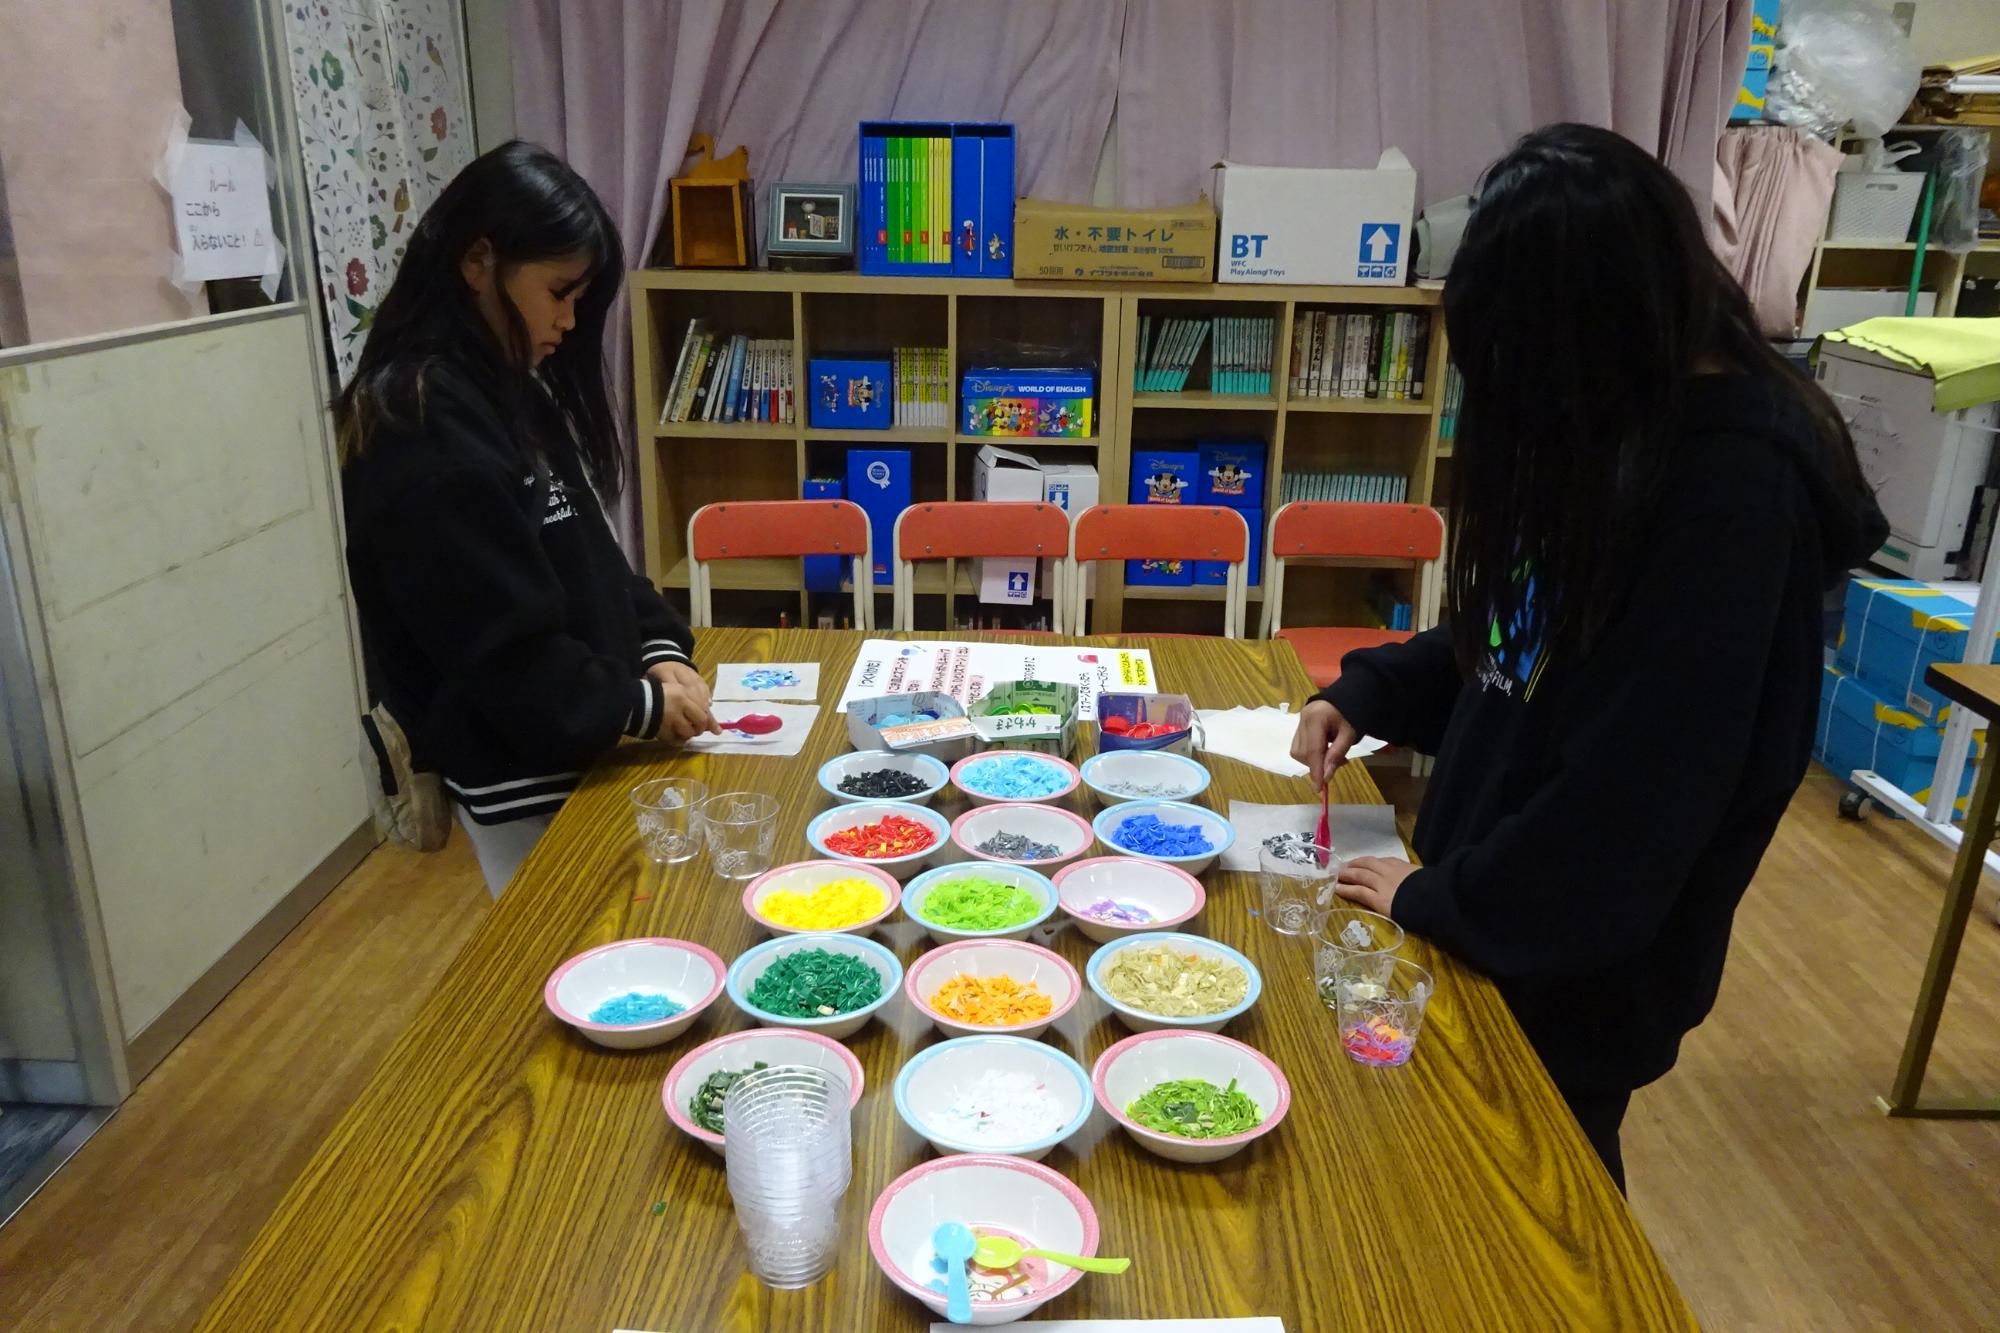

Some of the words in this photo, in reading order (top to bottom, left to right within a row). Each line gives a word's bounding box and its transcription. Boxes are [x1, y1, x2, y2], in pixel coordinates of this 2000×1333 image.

[185, 201, 222, 217] ここから
[1054, 225, 1175, 242] 水・不要トイレ
[1231, 234, 1269, 259] BT
[1230, 260, 1247, 268] WFC
[1230, 268, 1246, 277] Play
[1268, 269, 1286, 277] Toys
[1018, 385, 1044, 393] WORLD
[1045, 385, 1055, 393] OF
